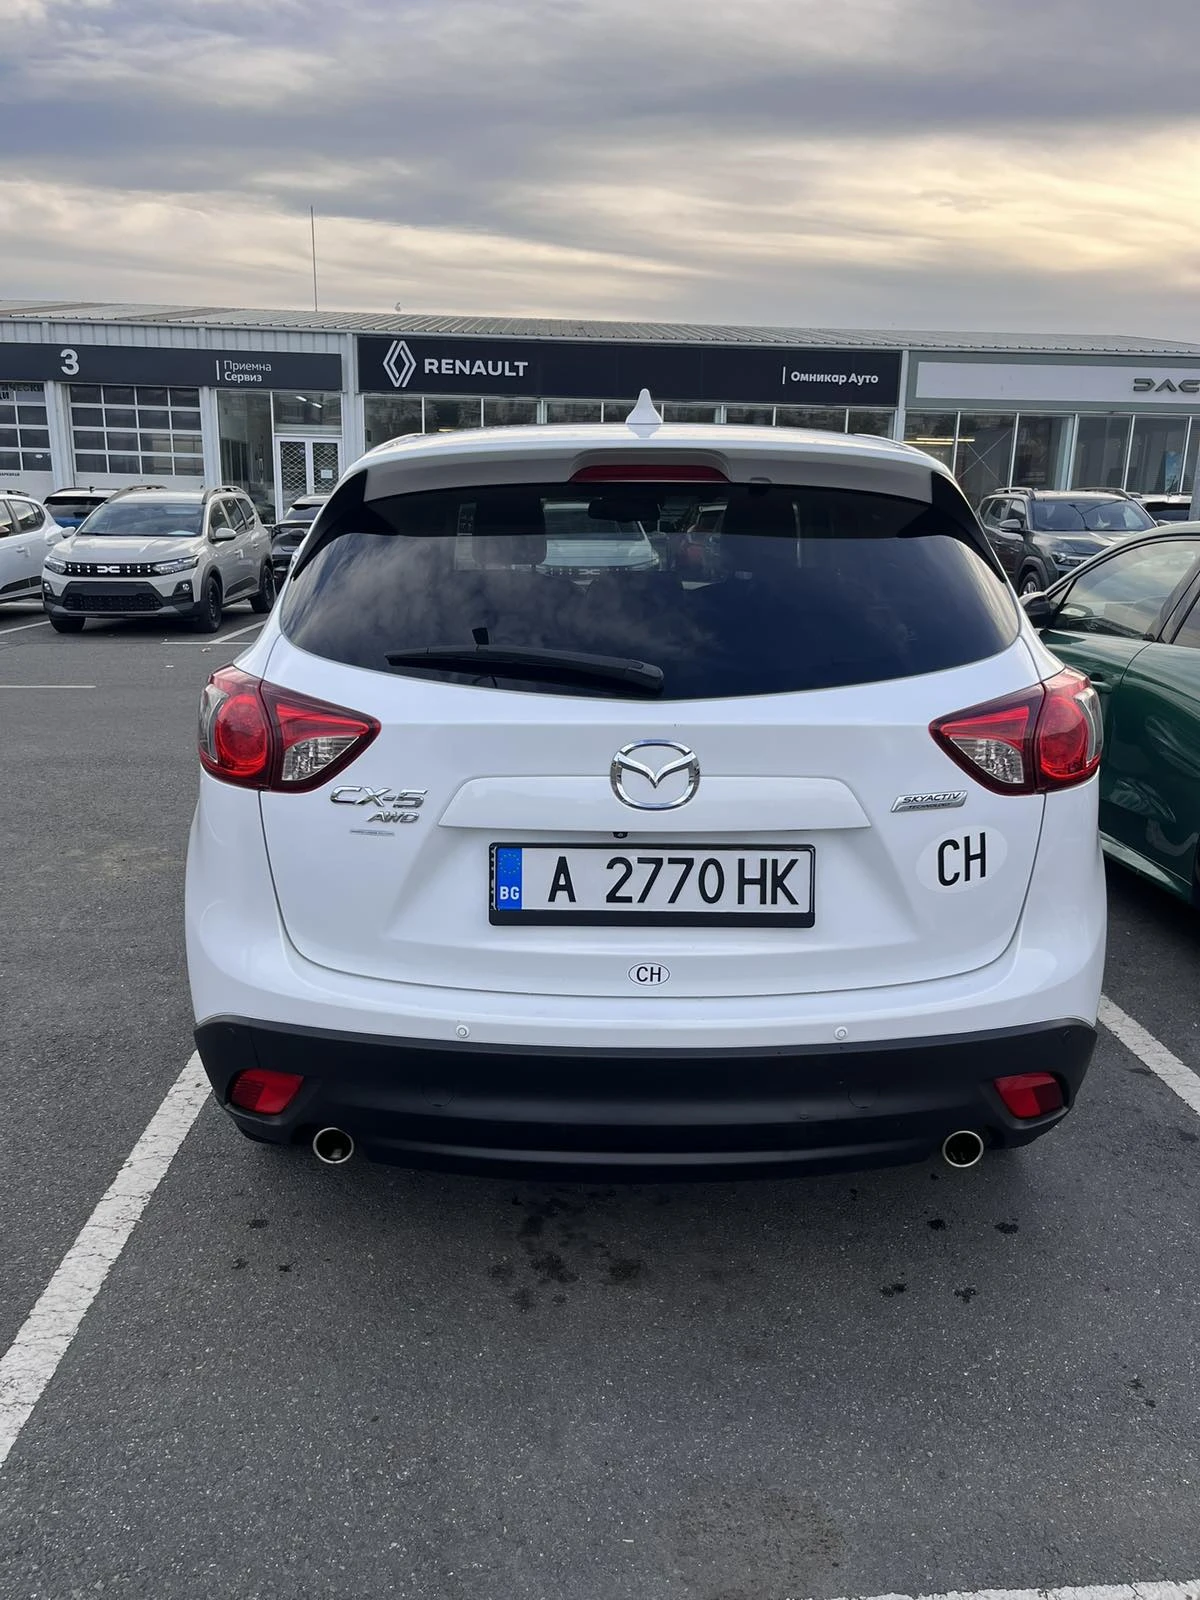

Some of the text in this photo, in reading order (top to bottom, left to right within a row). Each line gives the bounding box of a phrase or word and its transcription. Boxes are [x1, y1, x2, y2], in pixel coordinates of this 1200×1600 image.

[60, 348, 80, 375] 3
[223, 360, 272, 373] Приемна
[424, 358, 528, 377] RENAULT
[224, 371, 263, 383] Сервиз
[790, 371, 879, 386] Омникар Ауто
[330, 786, 429, 808] CX-5
[902, 792, 961, 803] SKYACTIV
[366, 810, 420, 823] AWD
[937, 832, 986, 887] CH
[547, 856, 800, 906] A 2770 HK
[499, 886, 520, 901] BG
[636, 966, 662, 982] CH
